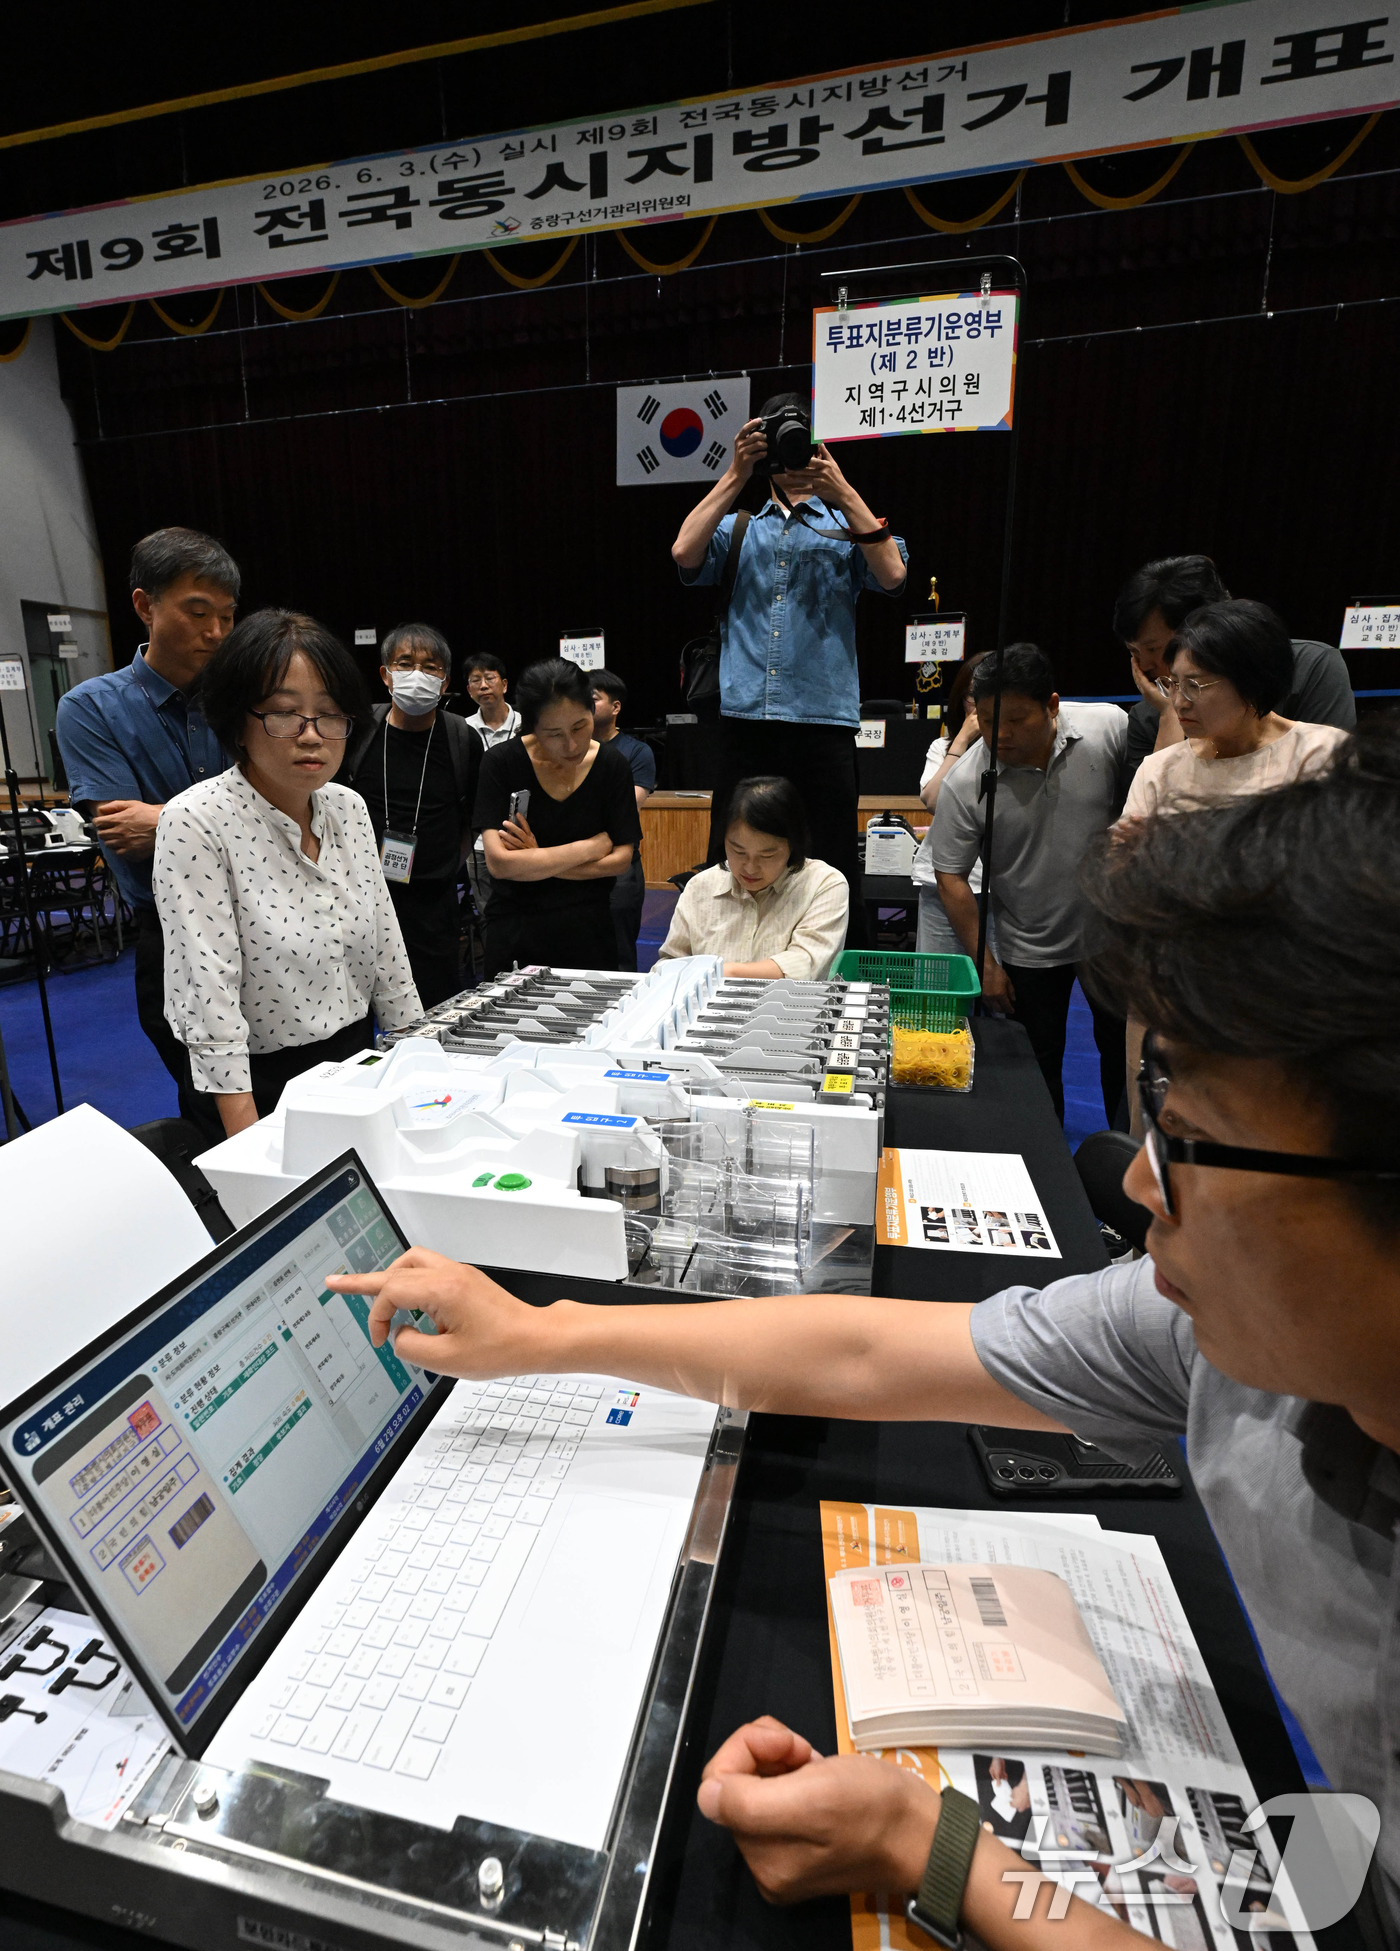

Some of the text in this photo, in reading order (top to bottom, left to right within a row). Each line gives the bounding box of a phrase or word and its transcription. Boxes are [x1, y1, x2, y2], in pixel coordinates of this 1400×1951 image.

[25, 17, 1395, 281] 제9회 전국동시지방선거 개표
[262, 175, 341, 200] 2026.
[356, 167, 382, 184] 6.
[499, 134, 557, 162] 실시
[576, 116, 658, 146] 제9회
[678, 60, 969, 130] 전국동시지방선거
[530, 194, 691, 230] 중랑구선거관리위원회
[826, 309, 1003, 354] 투표지분류기운영부
[870, 344, 954, 376] (제 2 반)
[859, 399, 963, 428] 제1·4선거구
[1361, 633, 1397, 642] 교육감
[171, 1338, 187, 1357] 정보
[178, 1386, 195, 1406] 분류
[206, 1361, 221, 1380] 정보
[189, 1384, 218, 1417] 진행 상태
[40, 1392, 85, 1434] 개표 관리
[228, 1444, 255, 1479] 집계 결과
[88, 1474, 130, 1520] 더불어민주당
[905, 1632, 923, 1678] 더불어민주당
